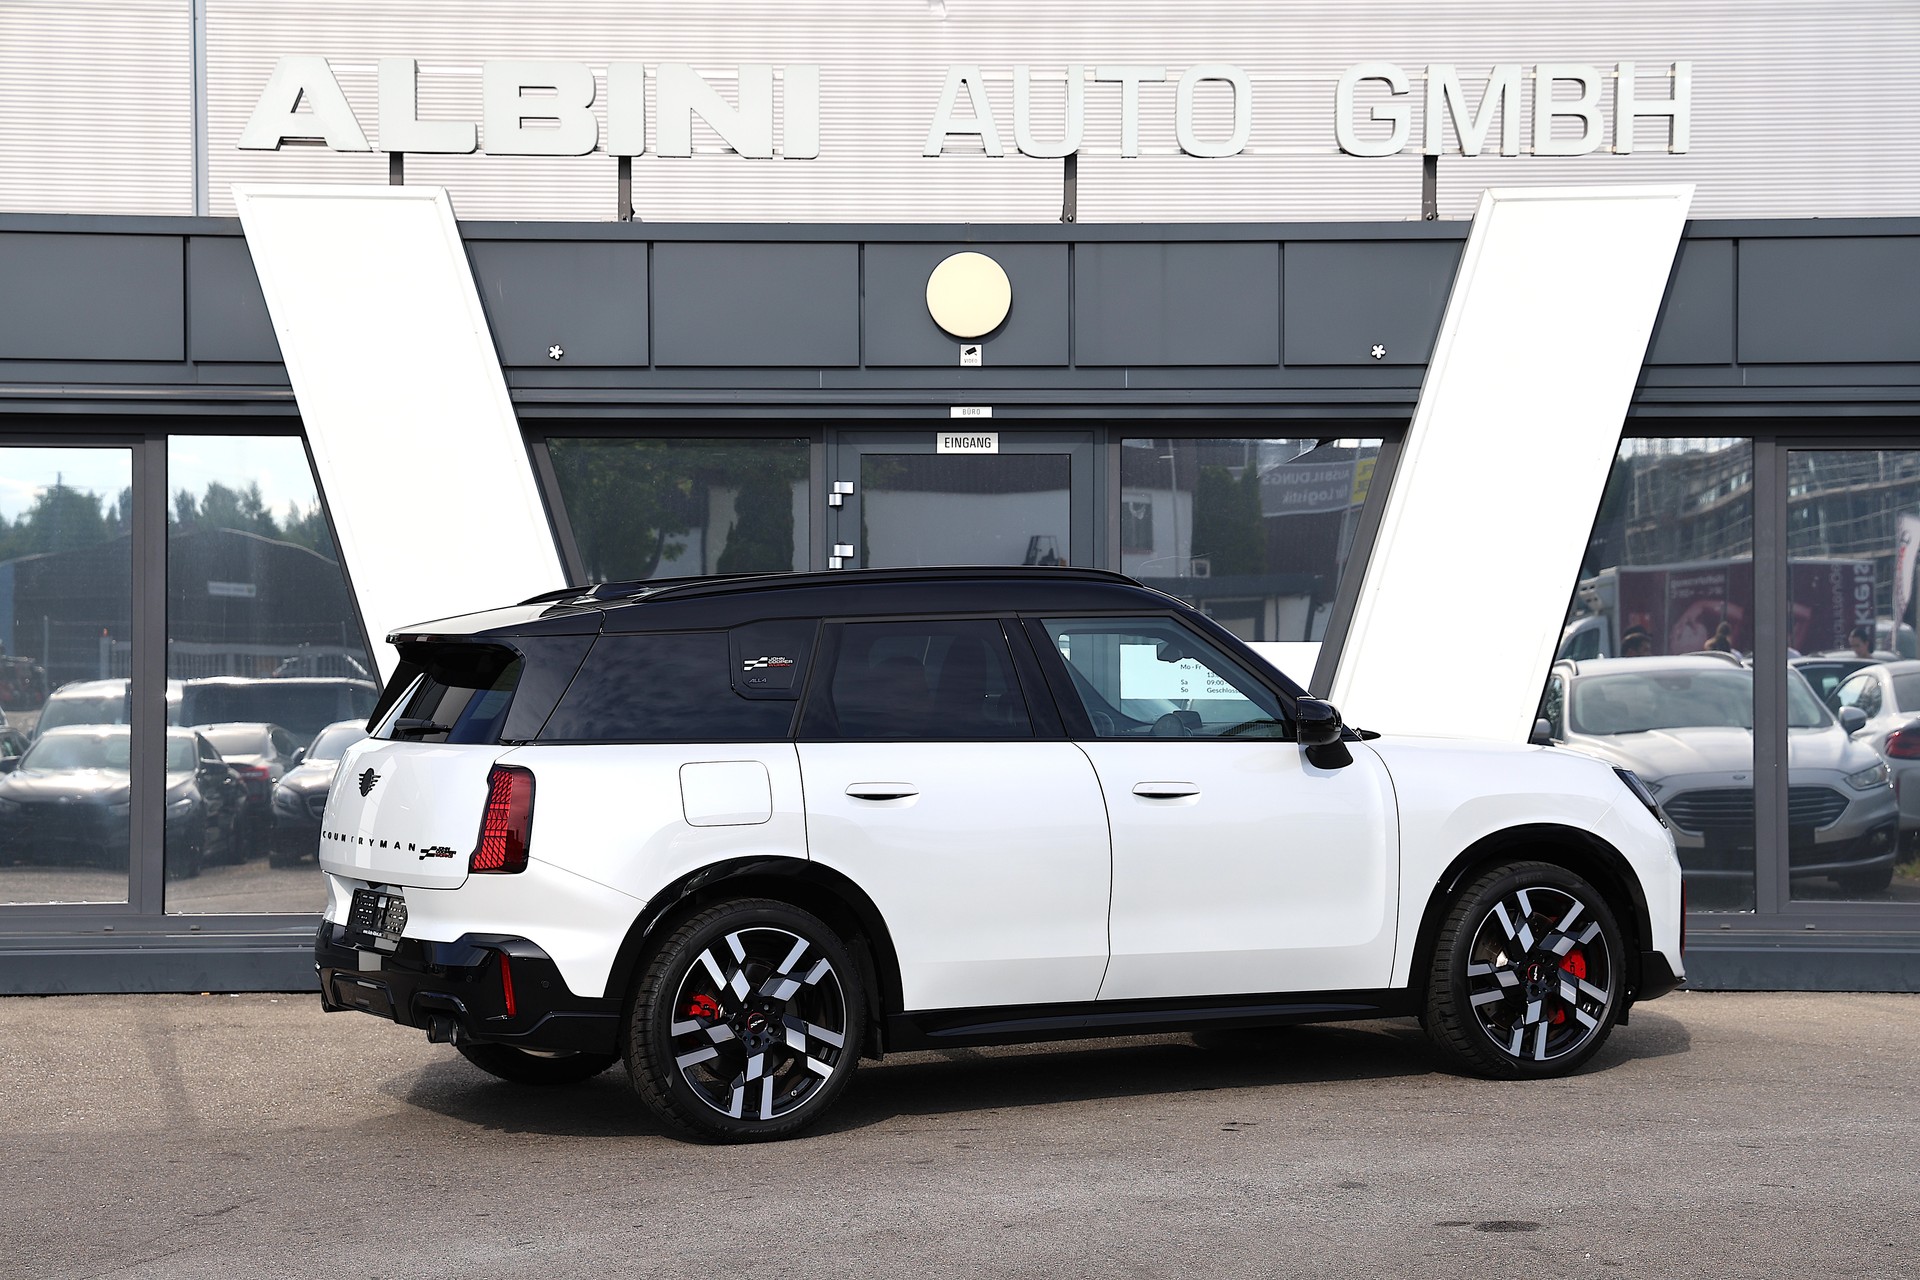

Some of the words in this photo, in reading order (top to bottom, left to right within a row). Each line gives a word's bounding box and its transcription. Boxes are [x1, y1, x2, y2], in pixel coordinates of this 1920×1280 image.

[236, 55, 820, 160] ALBINI
[922, 63, 1253, 159] AUTO
[1334, 61, 1694, 157] GMBH
[962, 408, 981, 416] BÜRO
[944, 436, 992, 449] EINGANG
[322, 830, 417, 852] COUNTRYMAN
